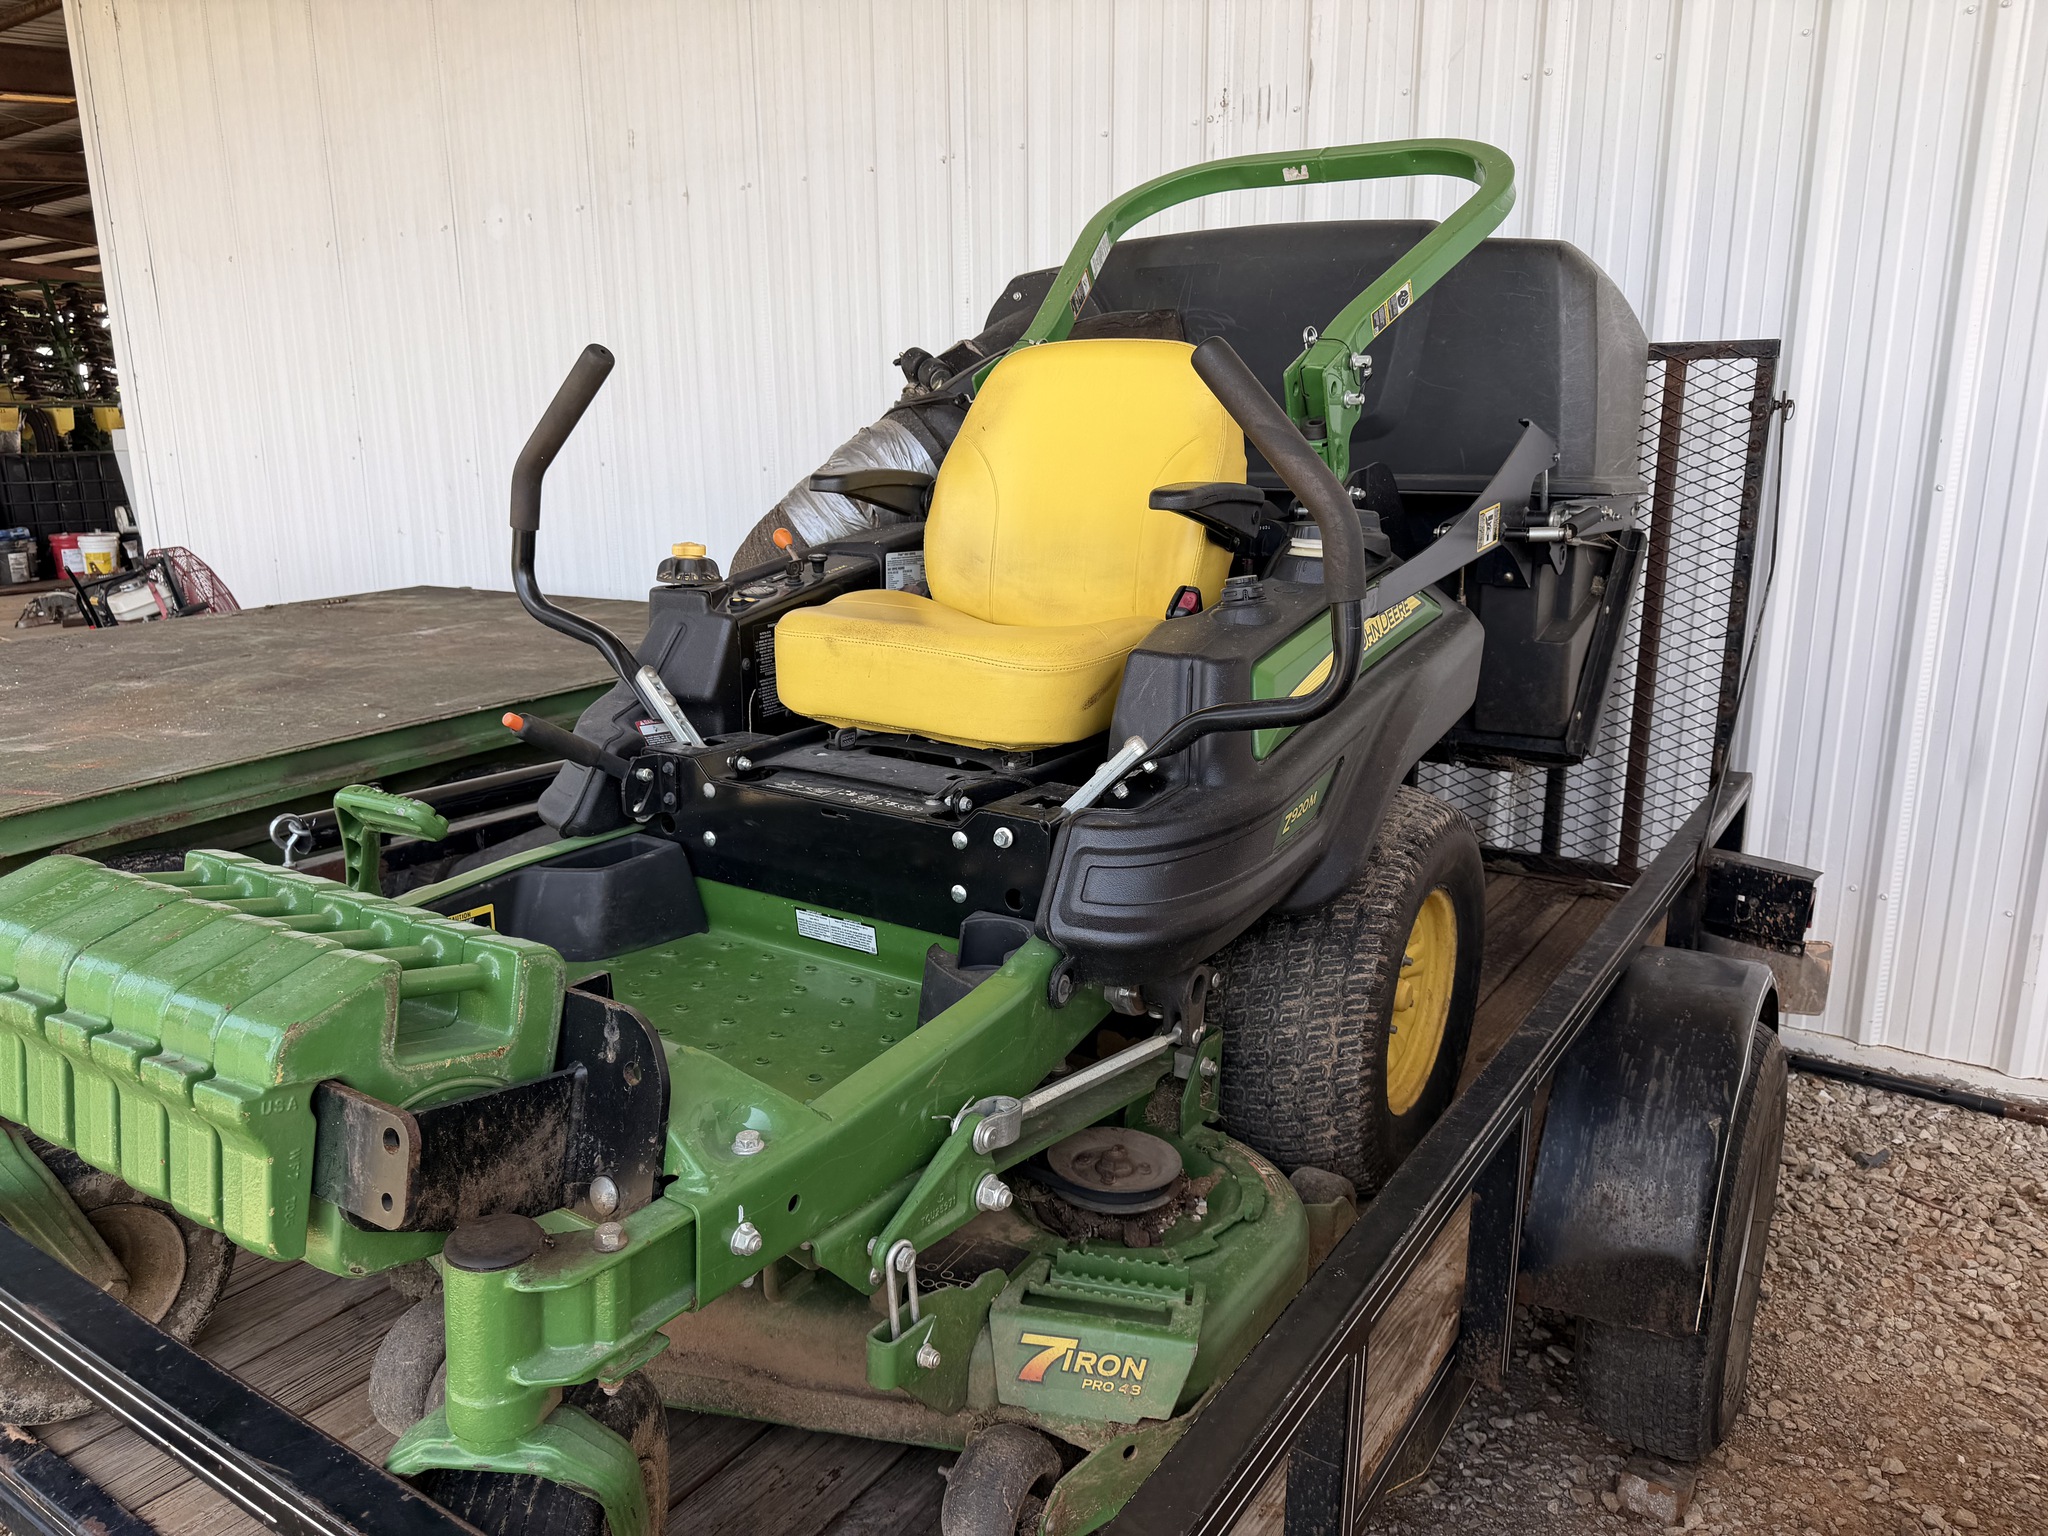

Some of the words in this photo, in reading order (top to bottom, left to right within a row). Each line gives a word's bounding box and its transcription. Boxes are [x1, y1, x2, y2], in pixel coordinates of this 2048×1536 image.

[1379, 601, 1411, 631] DEERE
[1282, 790, 1318, 835] Z920M
[260, 1095, 298, 1116] USA
[1080, 1378, 1116, 1393] PRO
